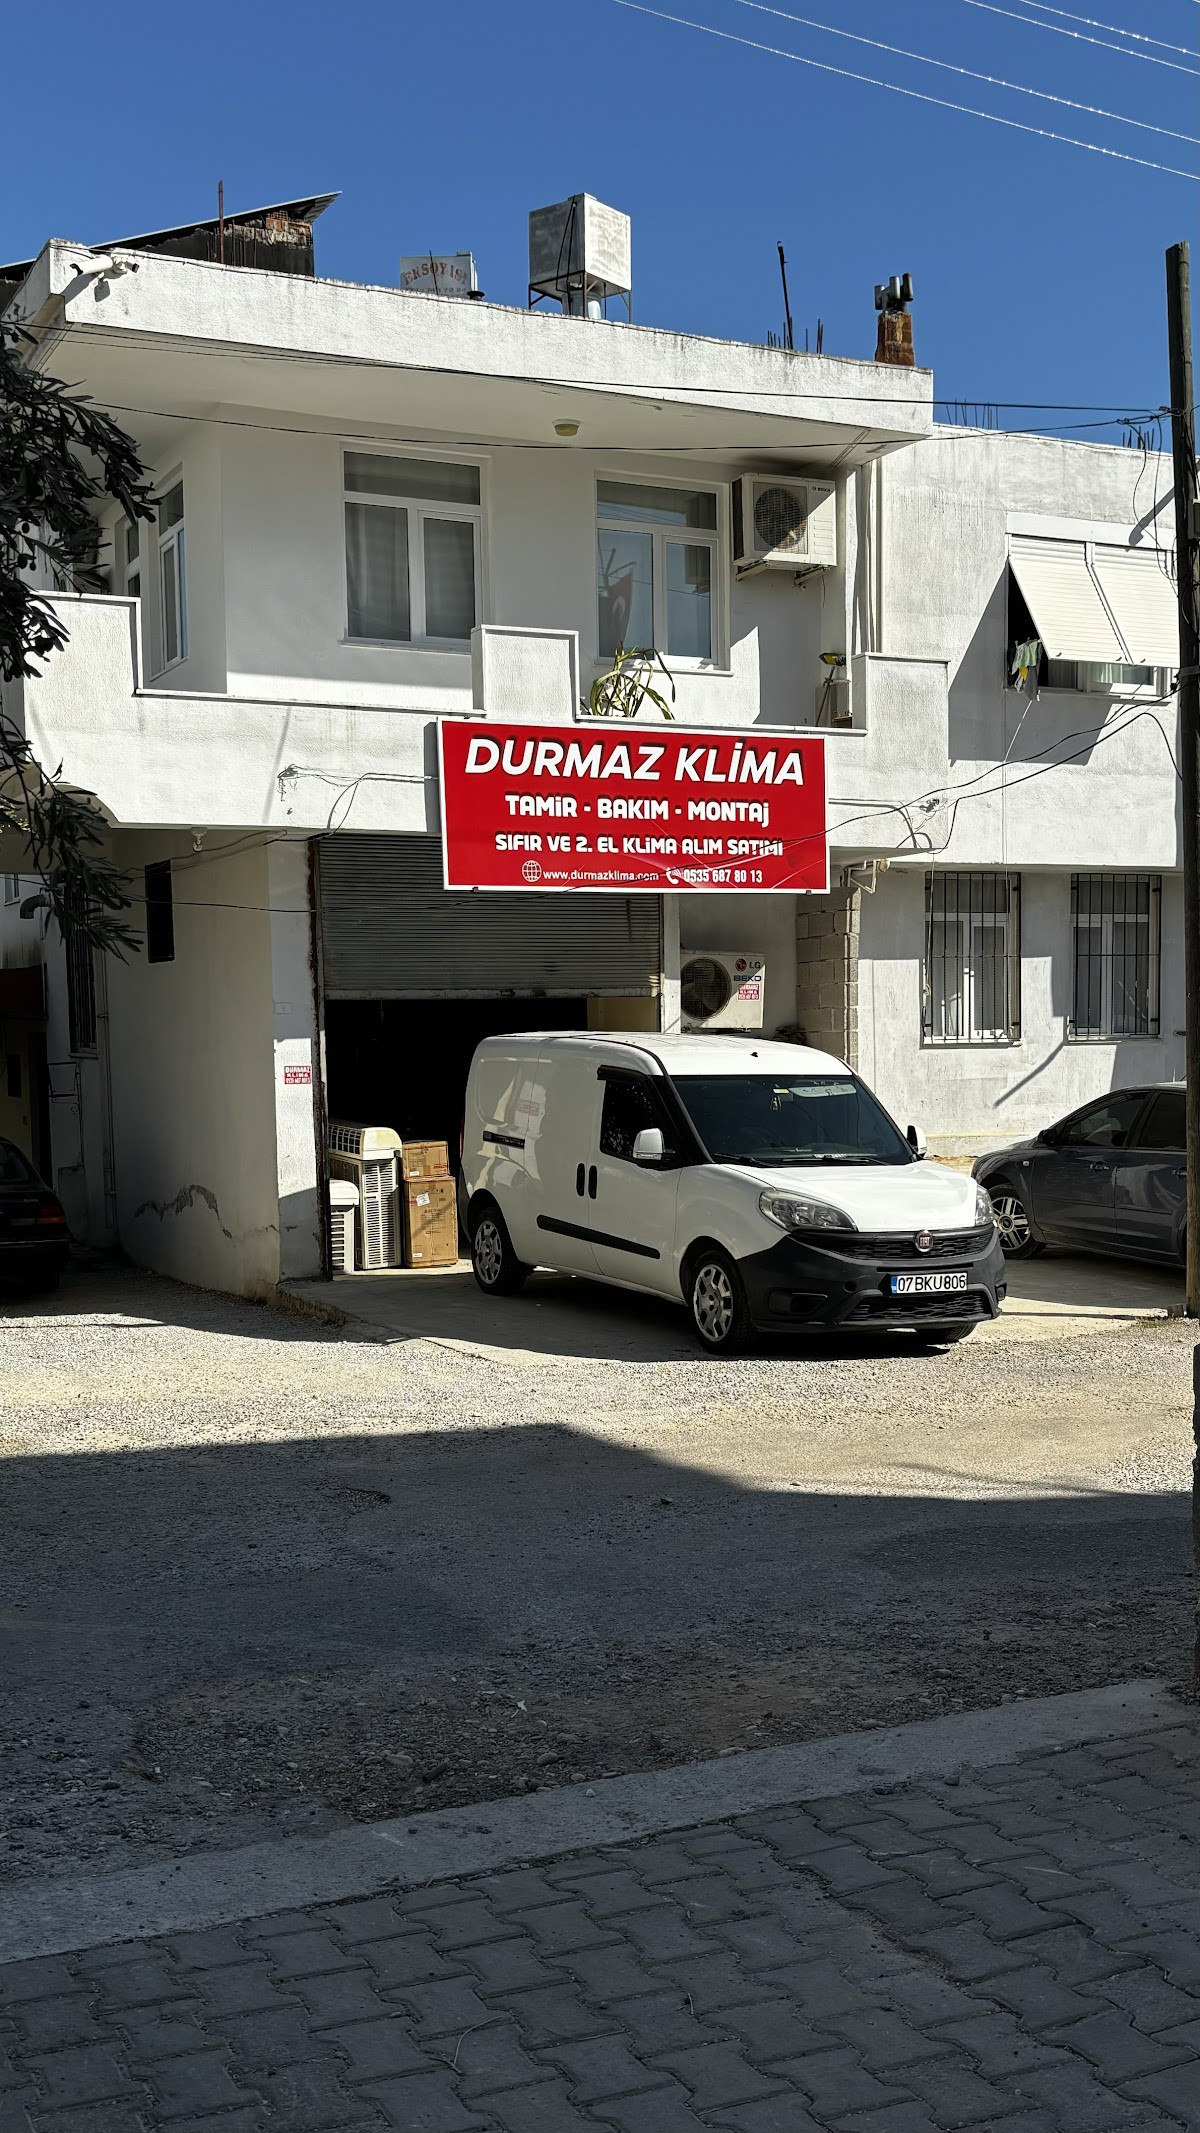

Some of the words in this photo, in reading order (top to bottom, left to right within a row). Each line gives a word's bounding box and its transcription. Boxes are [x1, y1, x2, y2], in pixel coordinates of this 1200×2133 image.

[465, 738, 664, 780] DURMAZ
[674, 741, 804, 785] KLİMA
[597, 798, 669, 820] BAKIM
[495, 834, 543, 852] SIFIR
[546, 835, 571, 852] VE
[575, 836, 593, 853] 2.
[597, 837, 619, 853] EL
[681, 839, 723, 855] ALIM
[727, 840, 783, 856] SATIMI
[543, 870, 659, 881] www.durmazklima.com
[684, 869, 709, 883] 0535
[712, 869, 732, 883] 687
[734, 869, 747, 883] 80
[750, 869, 763, 883] 13
[749, 961, 761, 969] LG
